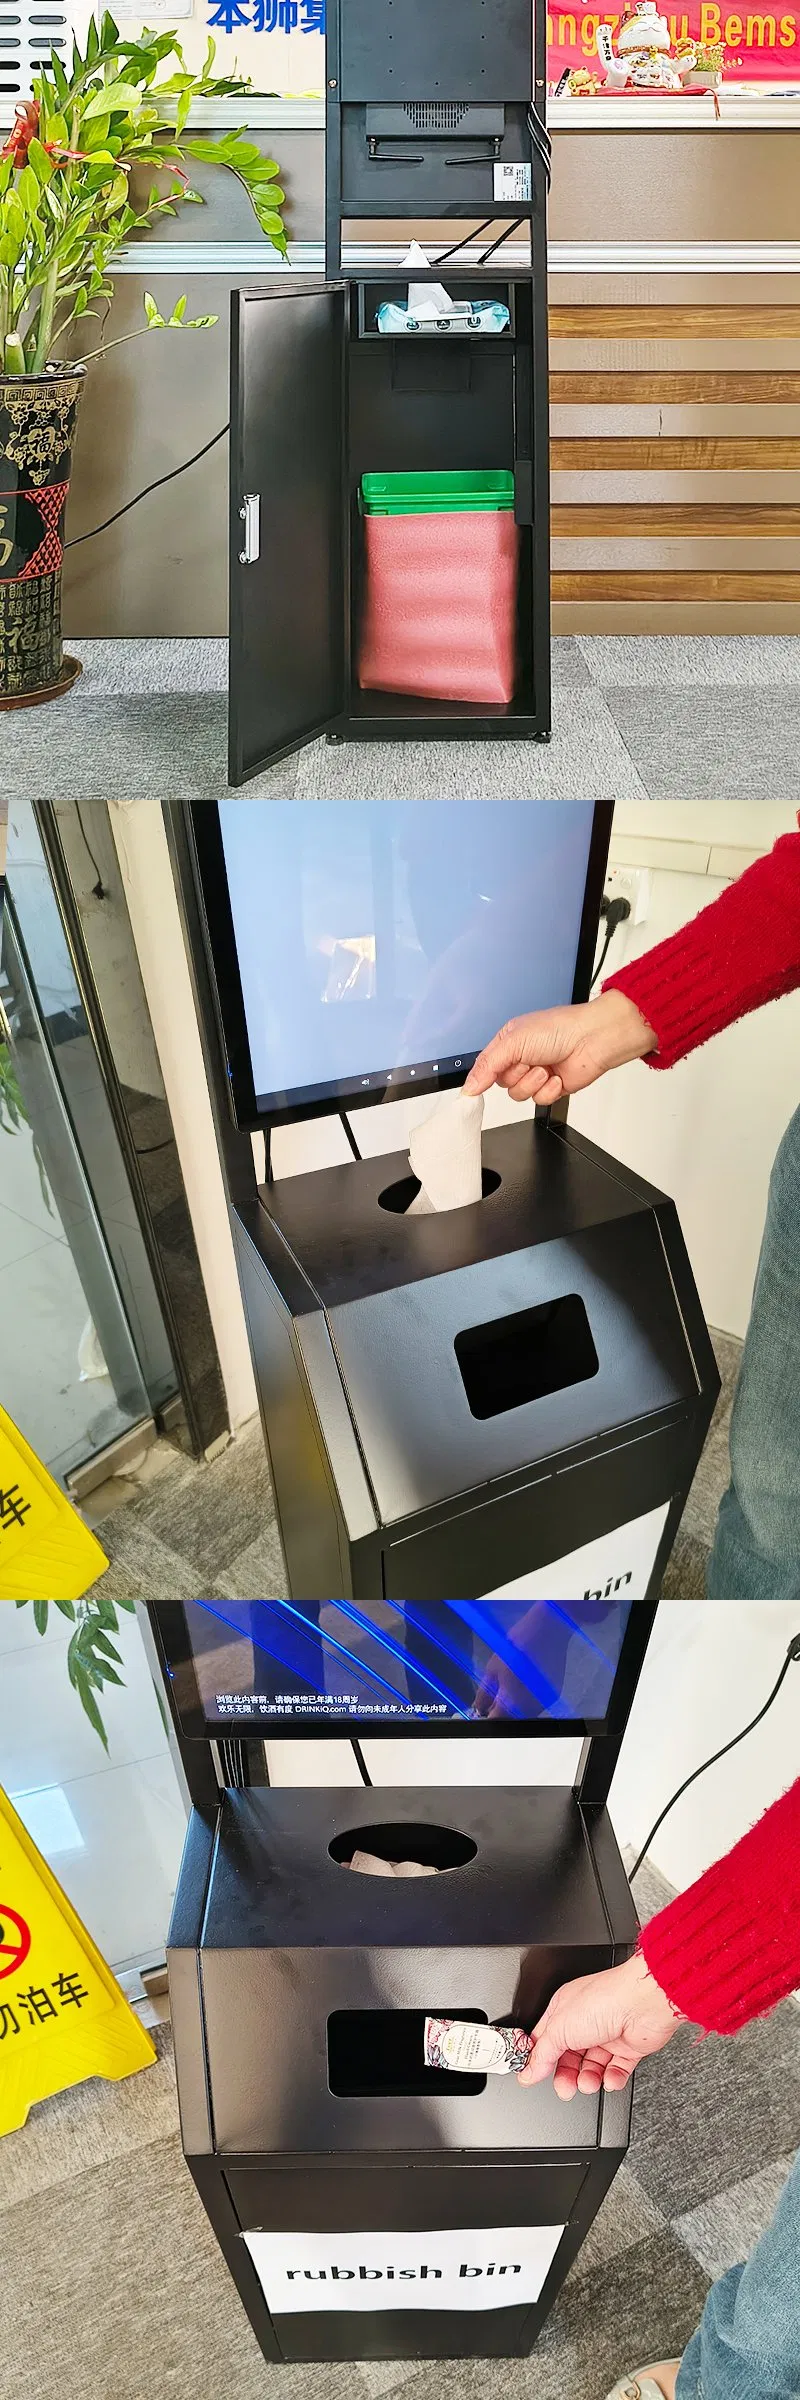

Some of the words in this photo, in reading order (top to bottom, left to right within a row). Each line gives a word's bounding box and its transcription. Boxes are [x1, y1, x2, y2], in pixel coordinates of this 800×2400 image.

[700, 3, 797, 47] Bems
[0, 1484, 31, 1530] 车
[286, 2265, 443, 2280] rubbish
[459, 2262, 522, 2278] bin
